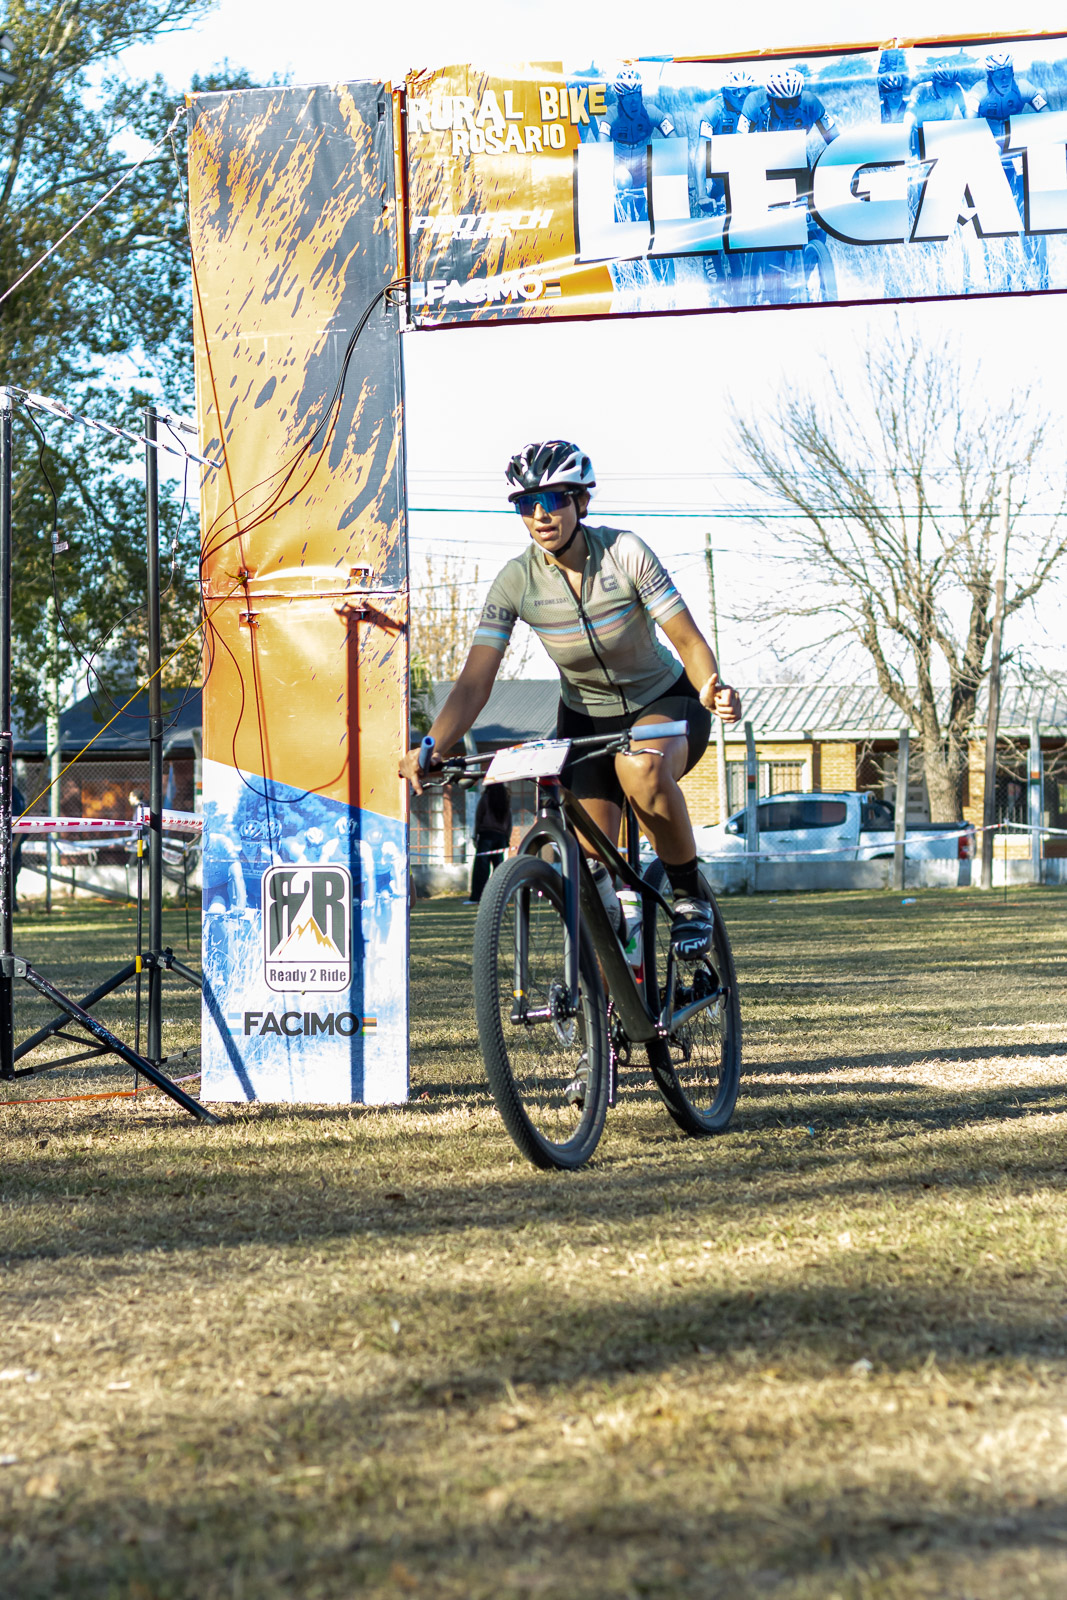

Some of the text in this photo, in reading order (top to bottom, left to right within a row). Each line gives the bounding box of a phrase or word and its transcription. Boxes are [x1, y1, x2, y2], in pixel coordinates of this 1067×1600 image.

[409, 84, 608, 133] RURAL BIKE
[452, 123, 565, 156] ROSARIO
[426, 275, 543, 304] FACIMO
[269, 968, 347, 983] Ready 2 Ride
[244, 1011, 360, 1037] FACIMO
